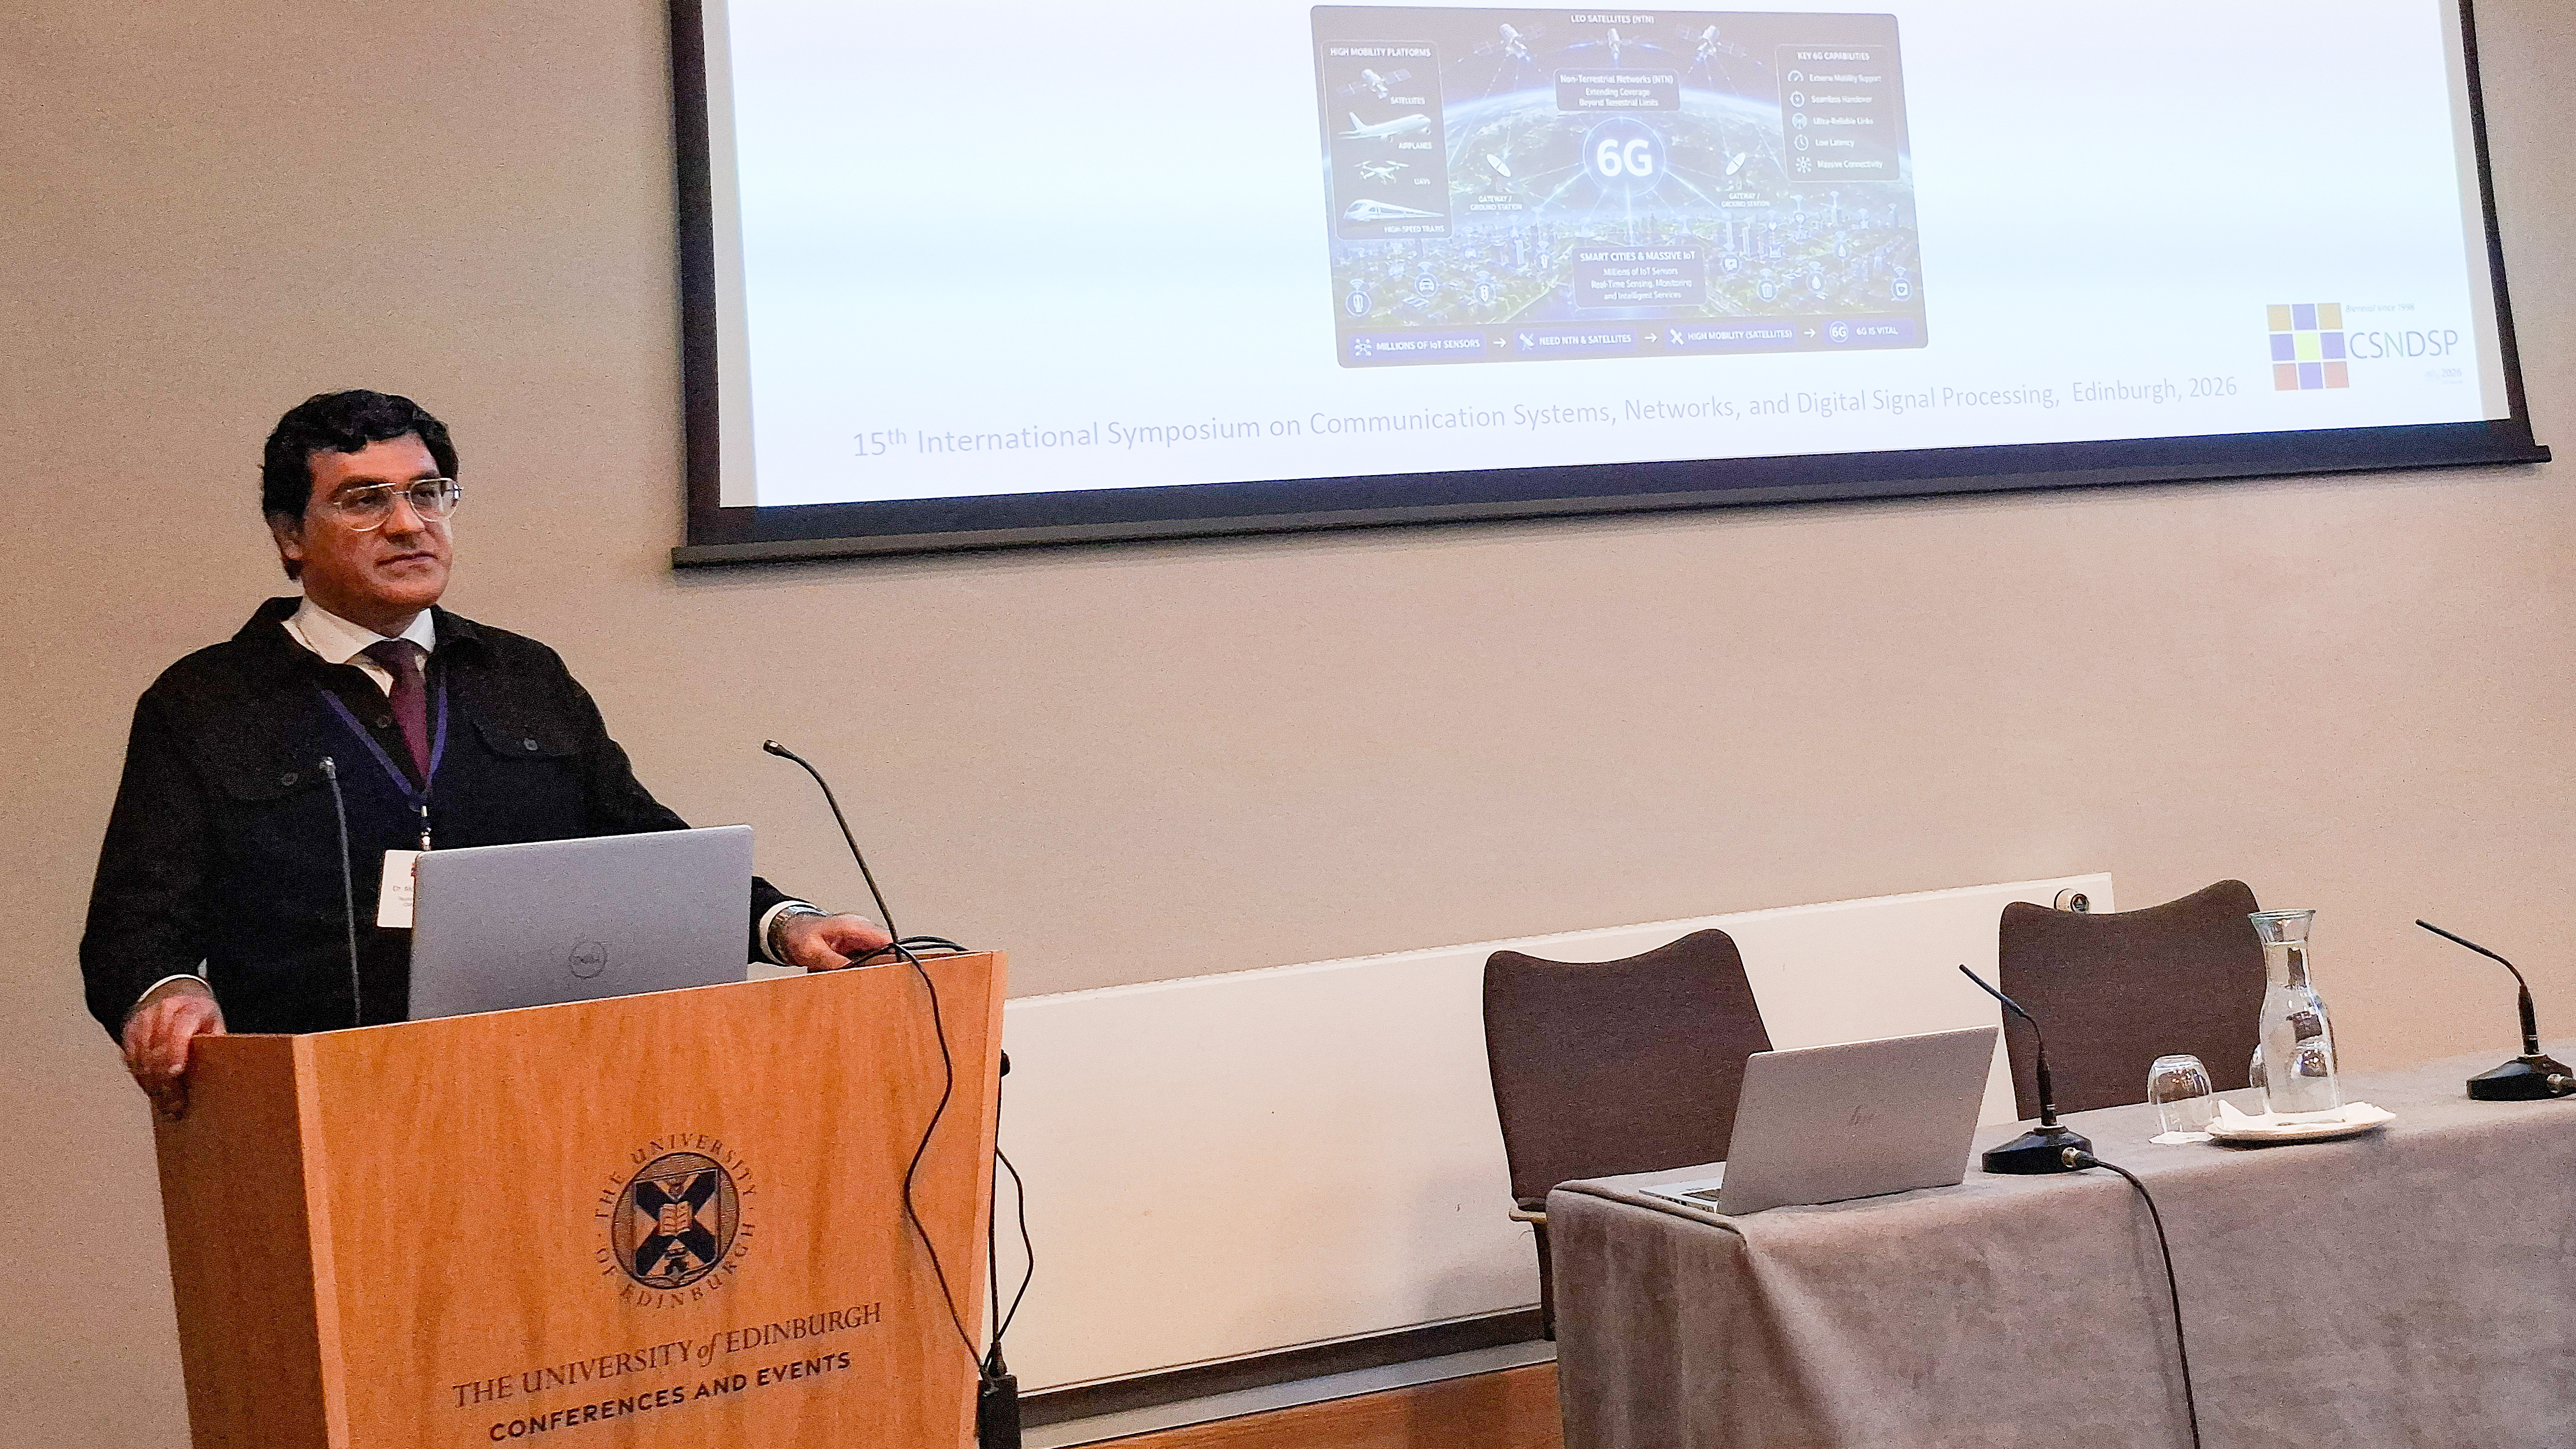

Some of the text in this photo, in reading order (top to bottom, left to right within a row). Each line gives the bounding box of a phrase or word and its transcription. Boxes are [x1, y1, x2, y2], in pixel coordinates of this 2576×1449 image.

[1588, 15, 1631, 23] SATELLITES
[1330, 47, 1431, 57] HIGH MOBILITY PLATFORMS
[1797, 52, 1812, 60] KEY
[1824, 51, 1871, 61] CAPABILITIES
[1560, 75, 1674, 85] Non-Terrestrial Networks (NTN)
[1620, 88, 1650, 98] Coverage
[1579, 98, 1605, 107] Beyond
[1597, 139, 1653, 177] 6G
[1579, 253, 1608, 262] SMART
[1610, 252, 1636, 261] CITIES
[1646, 251, 1681, 260] MASSIVE
[1688, 329, 1793, 340] HIGH MOBILITY (SATELLITES)
[1832, 327, 1846, 338] 6G
[1877, 326, 1898, 335] VITAL
[1376, 342, 1416, 351] MILLIONS
[1417, 341, 1428, 350] OF
[1444, 339, 1481, 349] SENSORS
[1539, 336, 1561, 346] NEED
[1562, 336, 1579, 344] NTN
[1588, 334, 1632, 344] SATELLITES
[2350, 329, 2458, 359] CSNDSP
[853, 376, 2237, 457] 15th International Symposium on Communication Systems, Networks, and Digital Signal Processing, Edinburgh, 2026
[594, 1133, 757, 1218] THE UNIVERSITY
[619, 1222, 756, 1309] EDINBURGH
[453, 1302, 881, 1407] THE UNIVERSITY of EDINBURGH
[489, 1351, 851, 1441] CONFERENCES AND EVENTS
